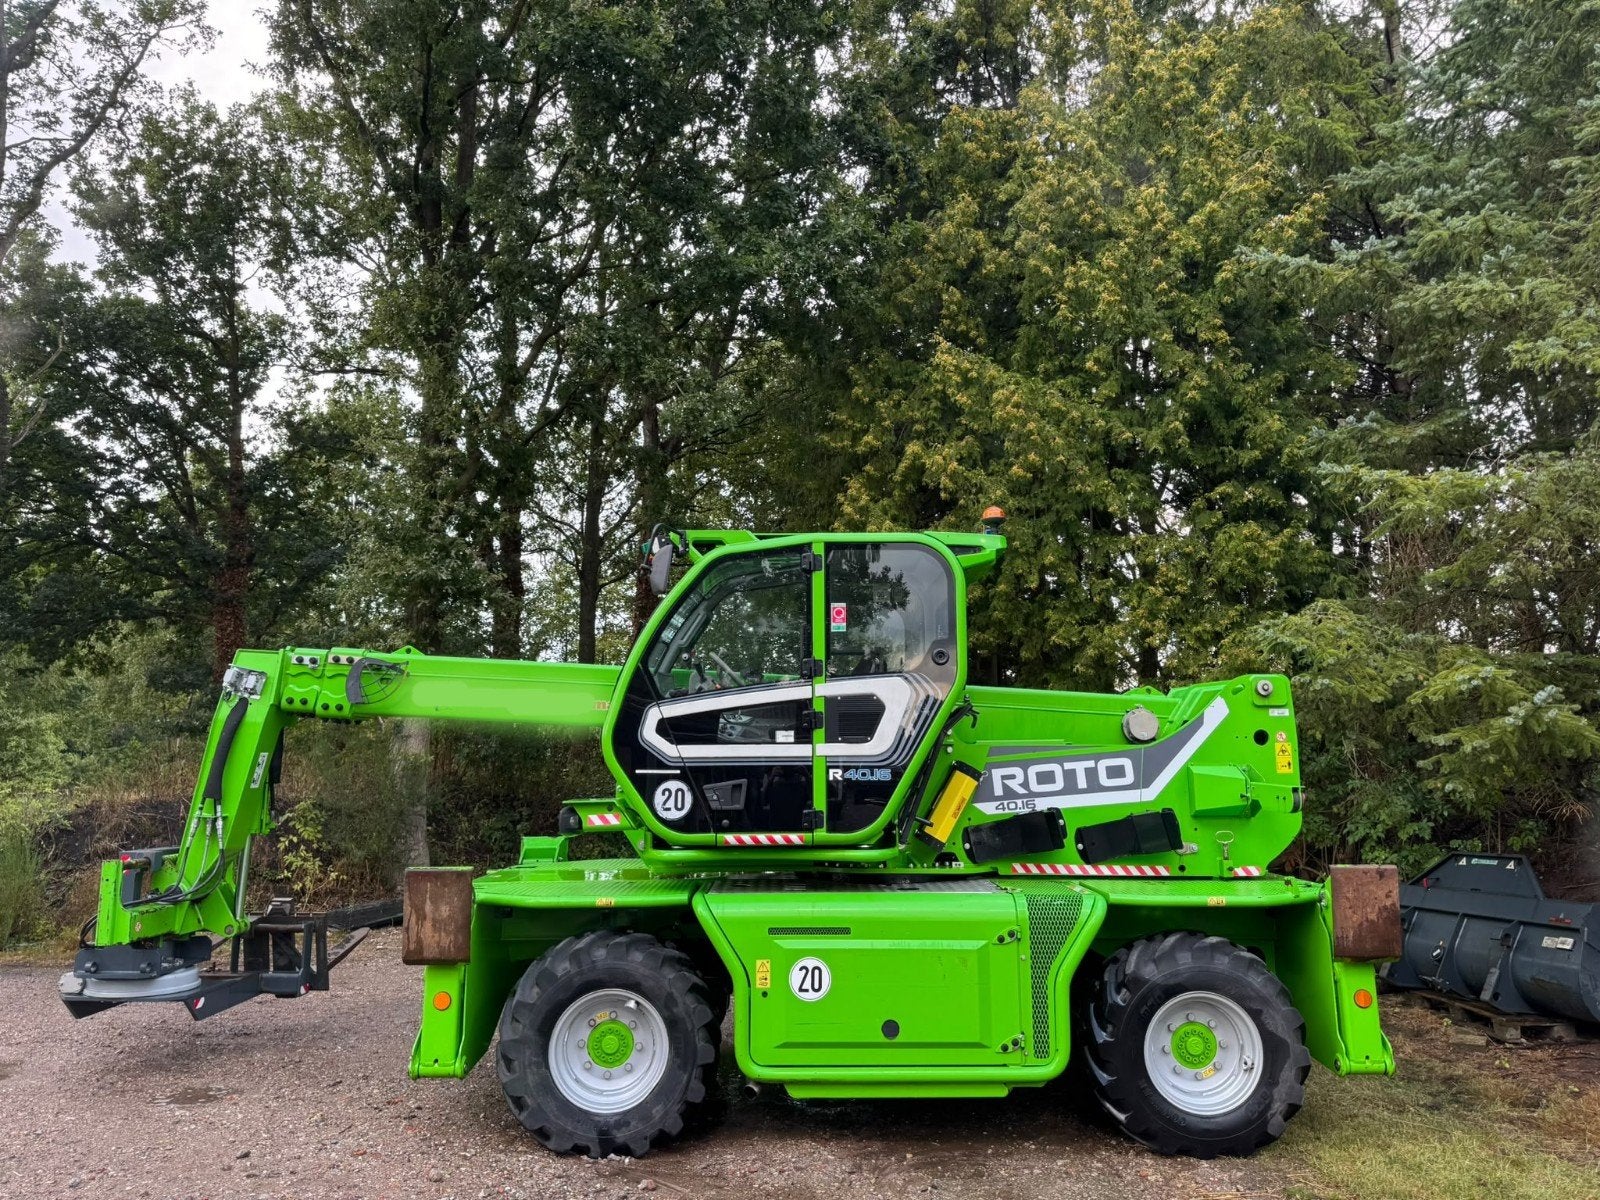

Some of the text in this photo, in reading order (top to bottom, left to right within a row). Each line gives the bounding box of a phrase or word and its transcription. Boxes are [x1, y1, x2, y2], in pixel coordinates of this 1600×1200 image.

[991, 757, 1136, 797] ROTO
[661, 788, 686, 812] 20
[994, 798, 1037, 812] 40.16
[797, 965, 823, 993] 20
